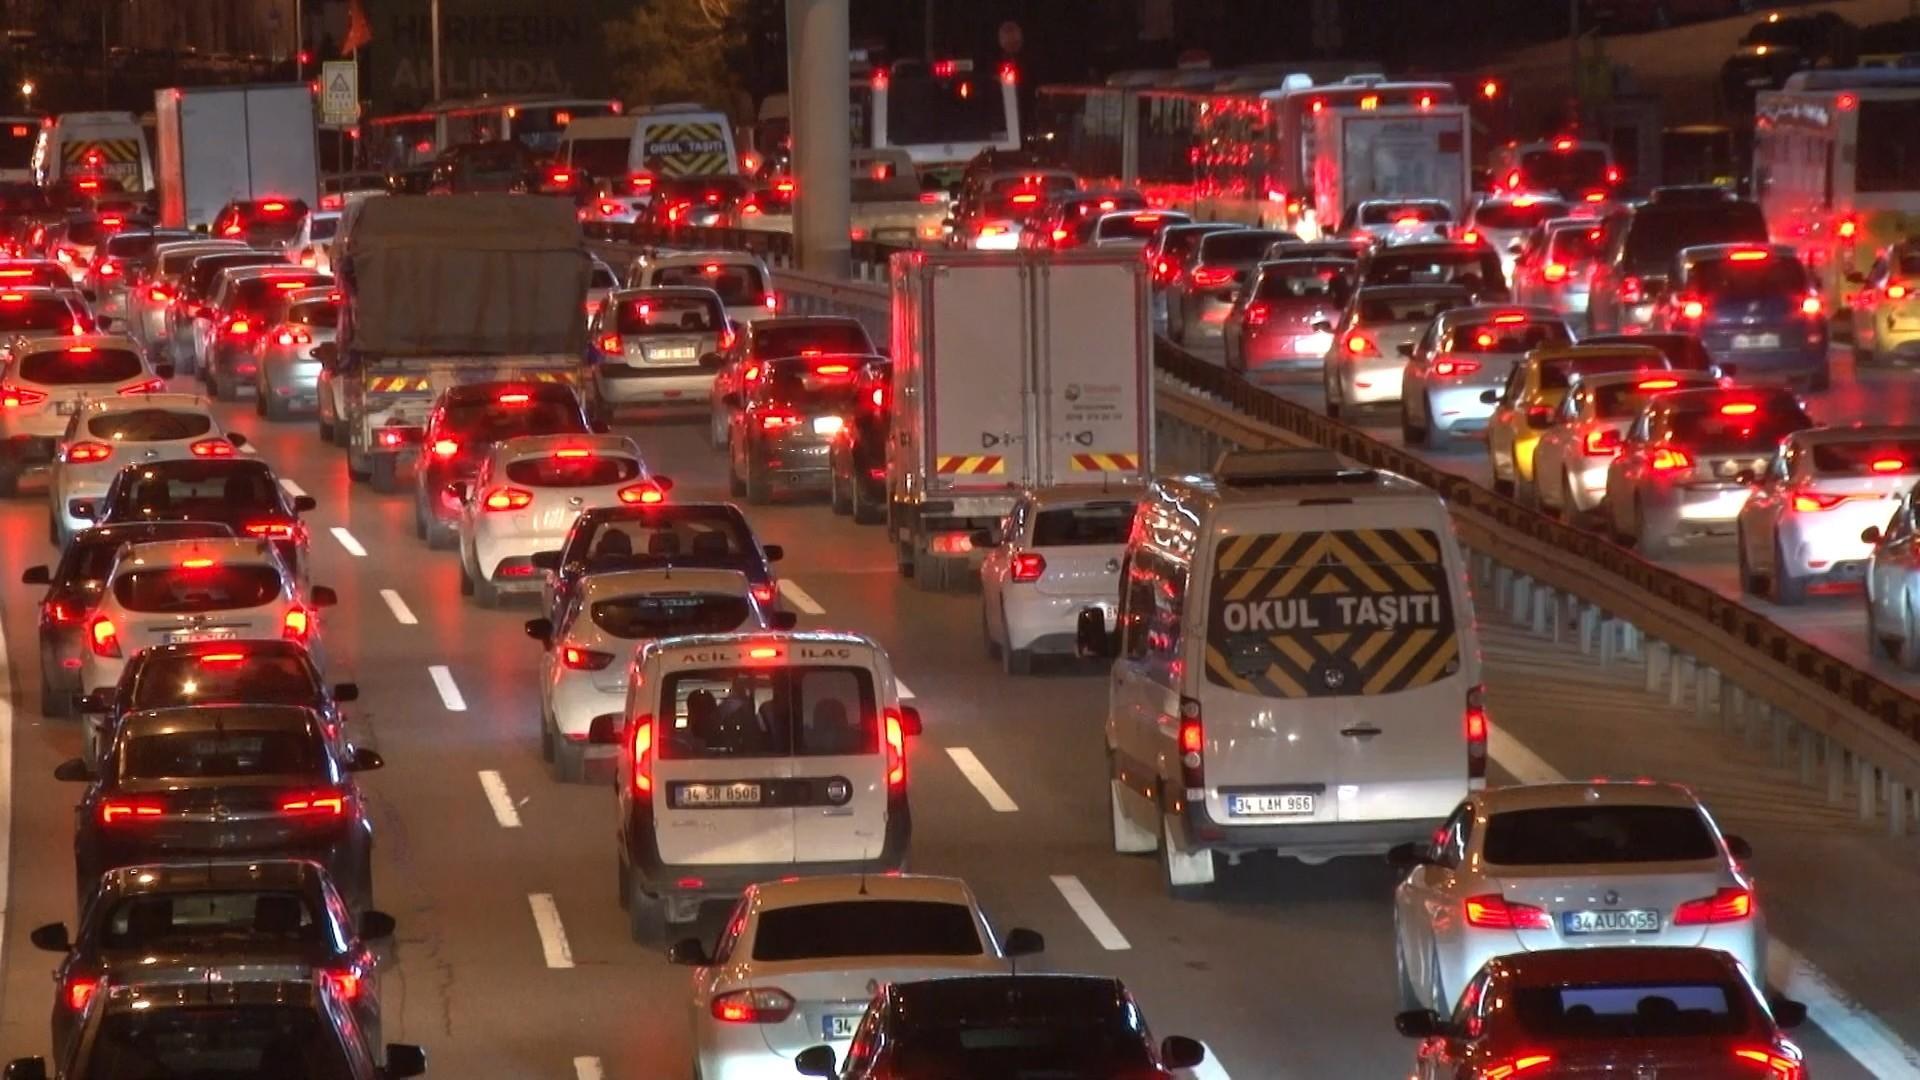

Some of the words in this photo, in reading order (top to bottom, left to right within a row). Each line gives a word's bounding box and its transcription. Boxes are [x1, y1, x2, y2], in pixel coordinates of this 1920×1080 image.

[650, 143, 682, 154] OKUL
[1223, 600, 1320, 633] OKUL
[1337, 594, 1440, 631] TAŞITI
[682, 651, 731, 663] ACİL
[801, 648, 850, 660] İLAÇ
[1238, 799, 1252, 812] 34
[1259, 798, 1281, 812] LAH
[834, 1019, 852, 1034] 34
